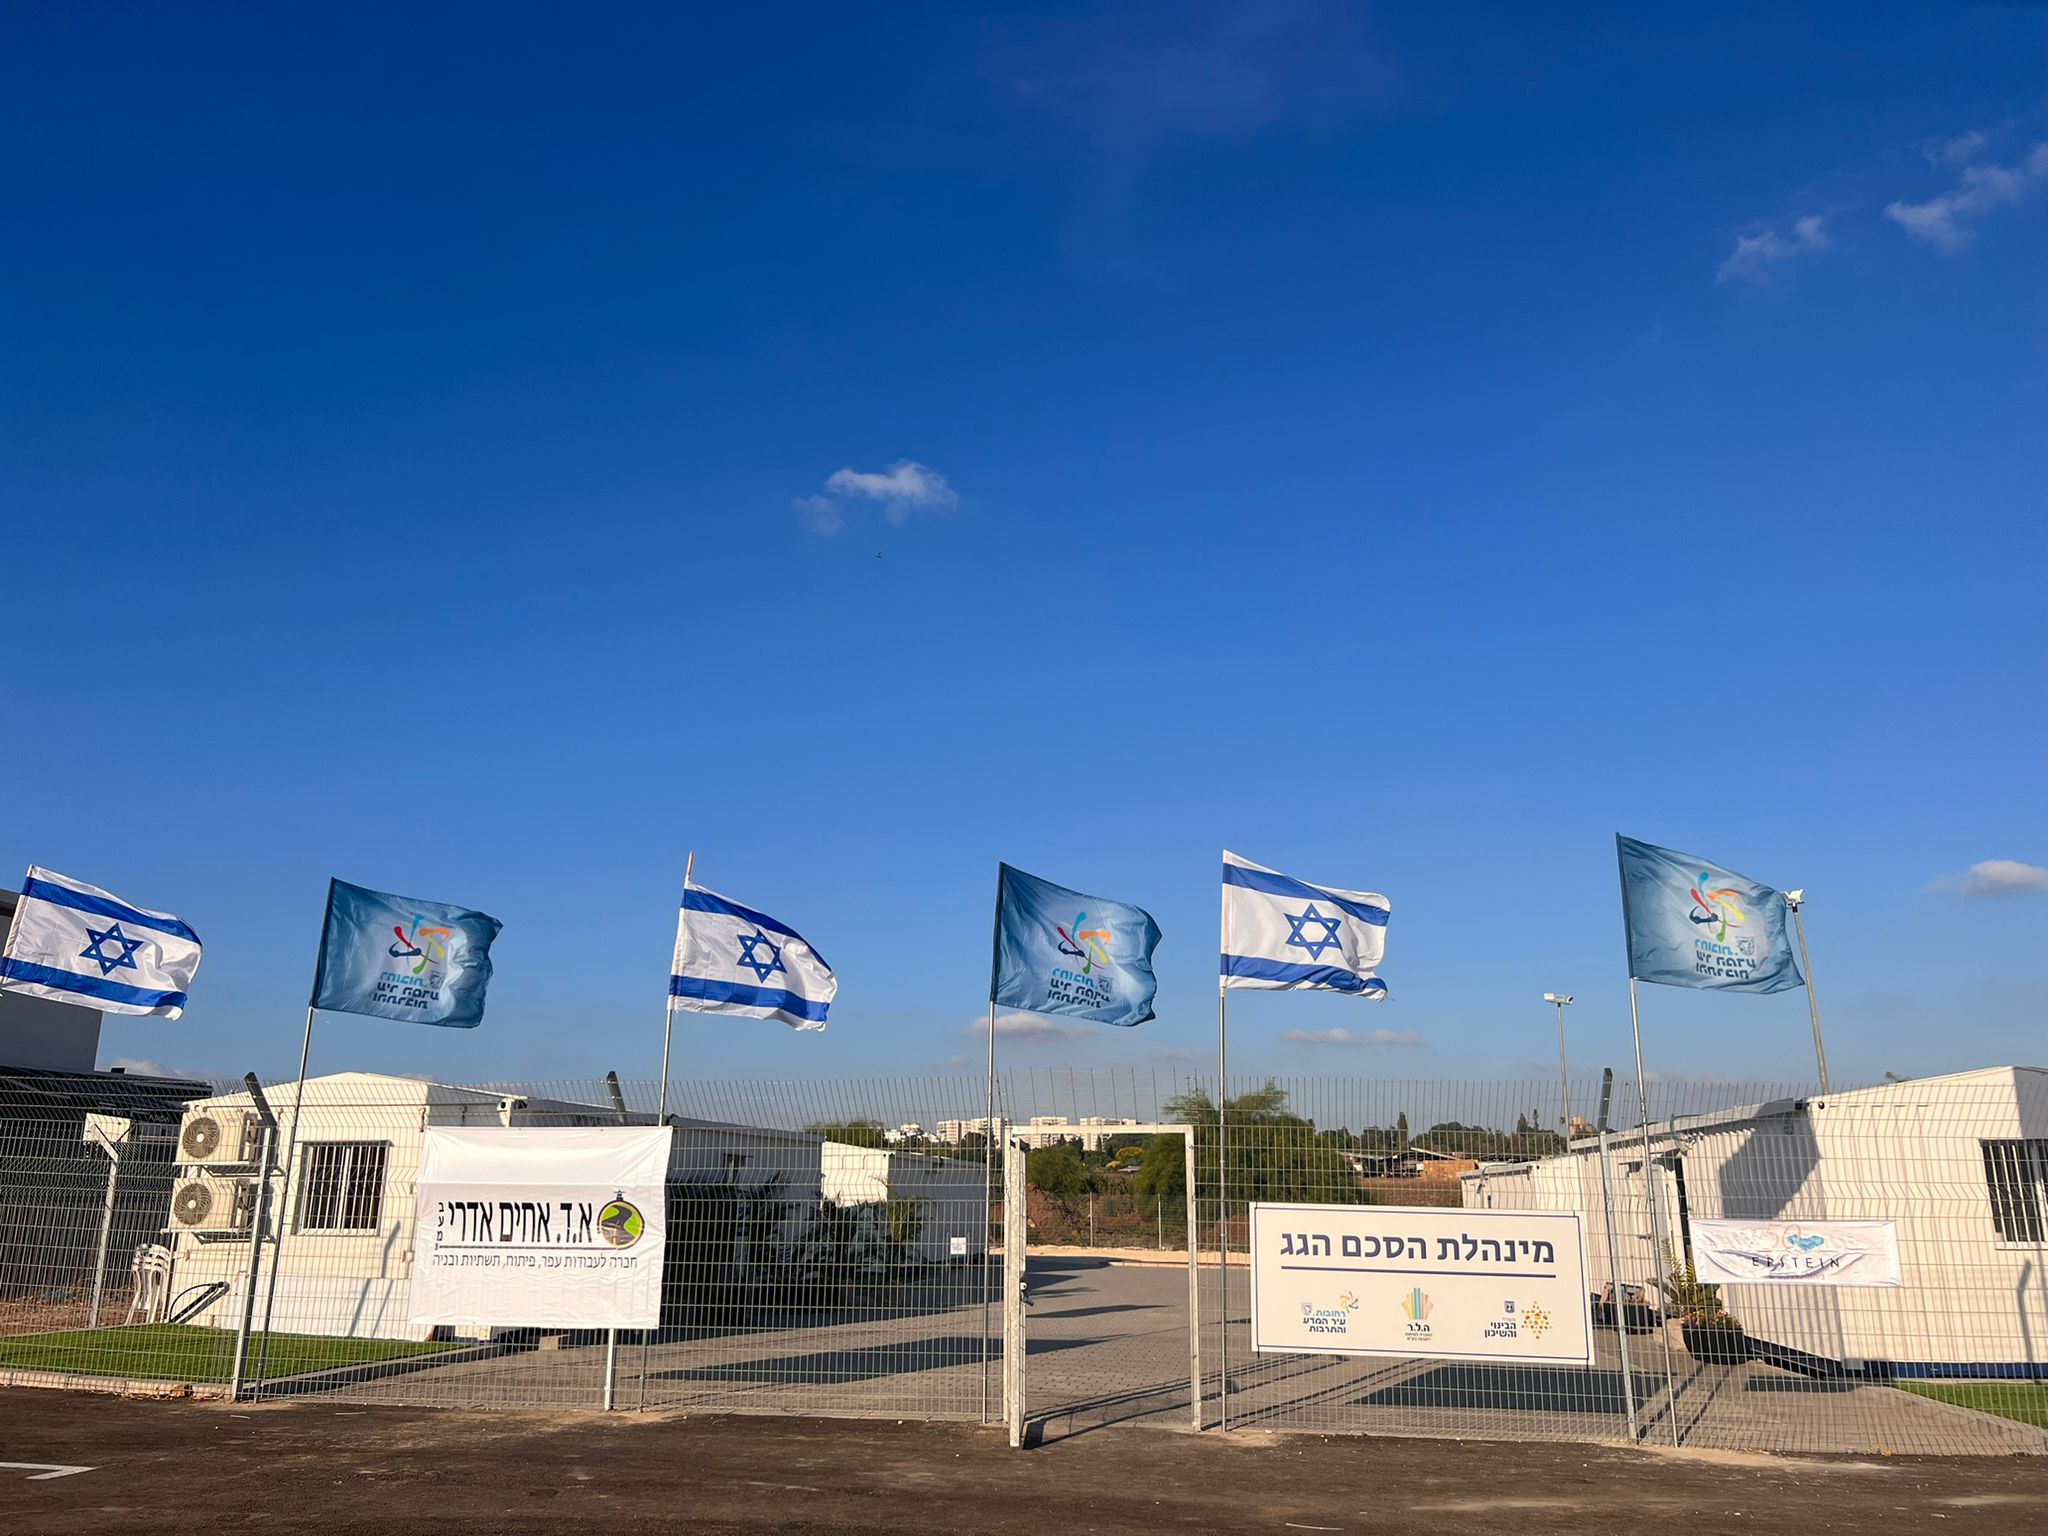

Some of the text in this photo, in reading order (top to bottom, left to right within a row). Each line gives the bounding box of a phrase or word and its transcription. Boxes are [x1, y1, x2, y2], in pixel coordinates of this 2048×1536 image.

[448, 1201, 493, 1242] אדרי
[499, 1202, 550, 1243] אחים
[1280, 1233, 1555, 1263] מינהלת הסכם הגג
[432, 1253, 638, 1269] חברה לעבודות עפר, פיתוח, תשתיות ובניה
[1752, 1256, 1840, 1269] EPSTEIN
[1303, 1317, 1329, 1325] המדע
[1490, 1322, 1517, 1330] הבינוי
[1309, 1325, 1347, 1333] והתרבות
[1484, 1329, 1517, 1338] והשיכון
